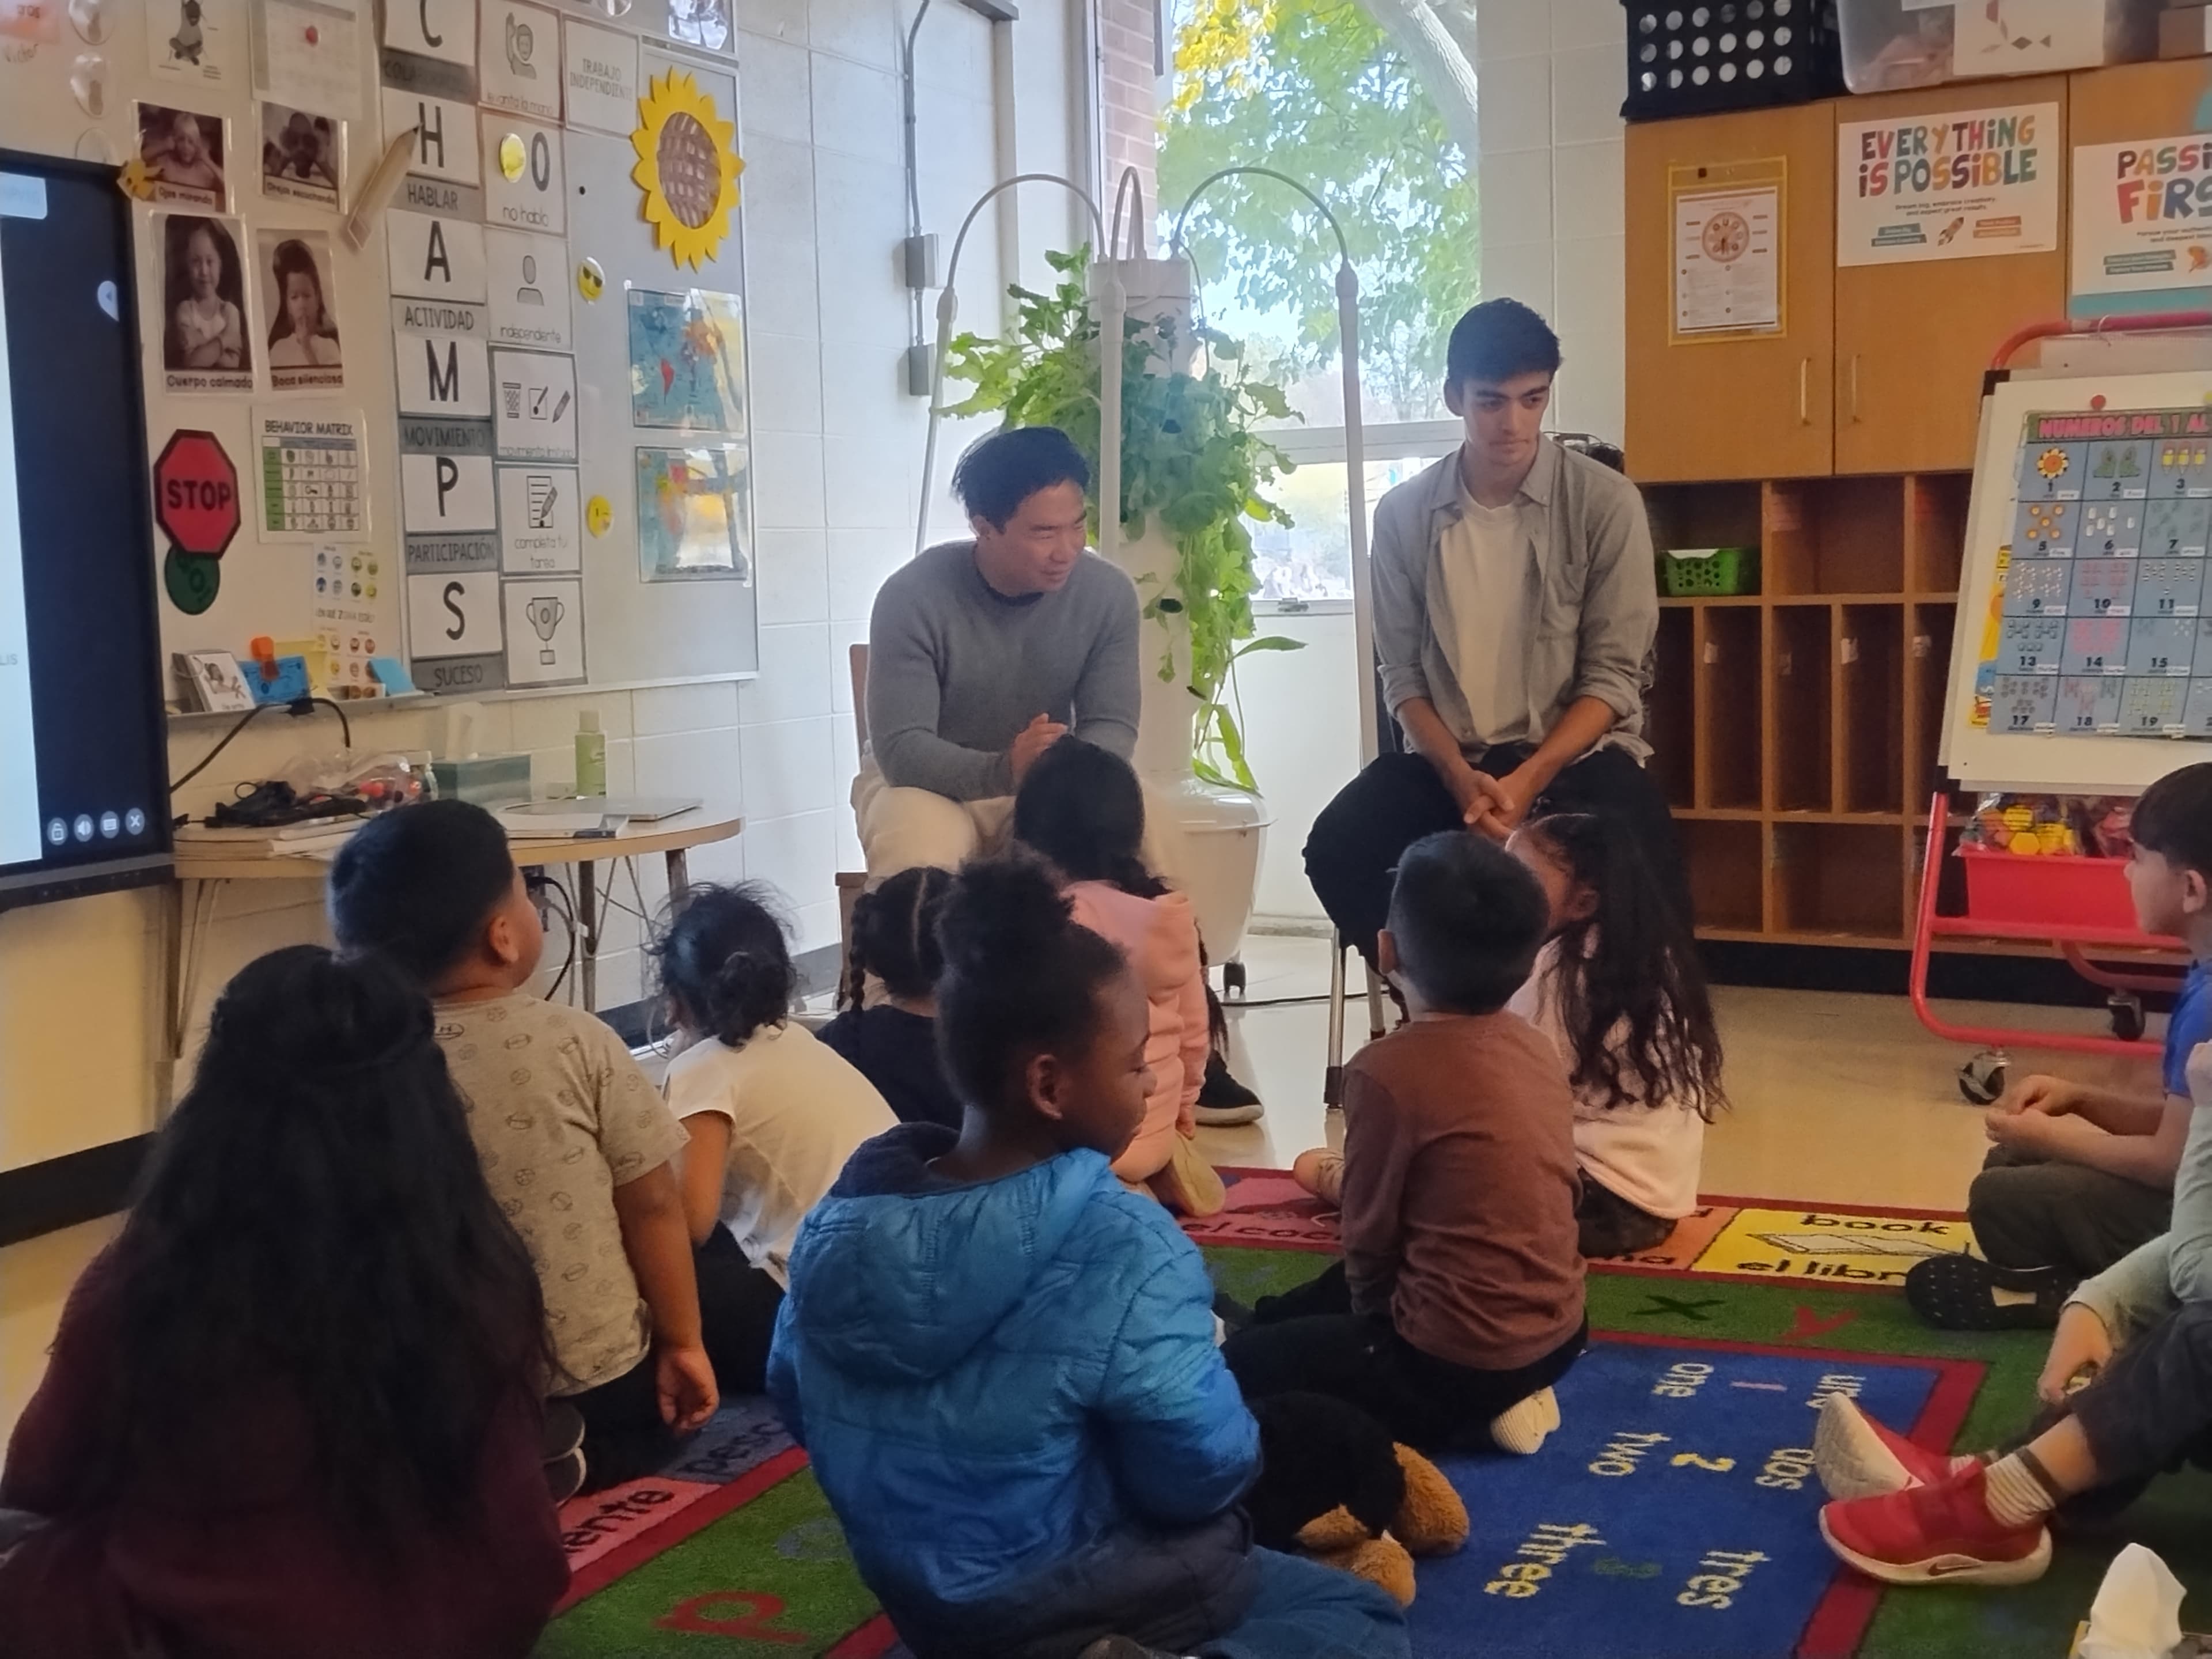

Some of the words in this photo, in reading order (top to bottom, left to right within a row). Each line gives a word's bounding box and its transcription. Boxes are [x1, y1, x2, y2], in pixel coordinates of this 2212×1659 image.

[583, 58, 622, 82] TRABAJO
[419, 102, 445, 168] H
[408, 183, 459, 211] HABLAR
[503, 206, 518, 222] no
[424, 220, 452, 283] A
[404, 305, 475, 331] ACTIVIDAD
[425, 339, 459, 402] M
[166, 375, 207, 389] Cuerpo
[209, 374, 253, 389] calmado
[272, 374, 296, 388] Boca
[265, 419, 314, 434] BEHAVIOR
[316, 421, 353, 436] MATRIX
[404, 426, 486, 448] MOVIMIENTO
[436, 456, 459, 517] P
[2112, 481, 2122, 492] 2
[2176, 478, 2186, 489] 3
[167, 479, 230, 511] STOP
[408, 537, 496, 563] PARTICIPACIÓN
[2038, 540, 2047, 551] 5
[2104, 540, 2115, 550] 6
[2168, 539, 2179, 549] 7
[443, 581, 465, 641] S
[2032, 598, 2041, 609] 9
[2094, 598, 2112, 609] 10
[2158, 598, 2175, 609] 11
[2020, 656, 2037, 667] 13
[2085, 656, 2103, 668] 14
[2151, 657, 2168, 668] 15
[434, 663, 484, 687] SUCESO
[2012, 715, 2030, 726] 17
[2075, 715, 2093, 727] 18
[2141, 716, 2159, 727] 19
[1234, 1226, 1342, 1241] coc
[1800, 1214, 1950, 1236] book
[1737, 1259, 1791, 1272] el
[1802, 1260, 1908, 1281] libr
[1651, 1362, 1714, 1398] one
[1588, 1431, 1671, 1476] two
[1671, 1452, 1736, 1472] 2
[1754, 1447, 1816, 1491] dos
[1483, 1522, 1607, 1599] three
[1675, 1550, 1772, 1609] tres
